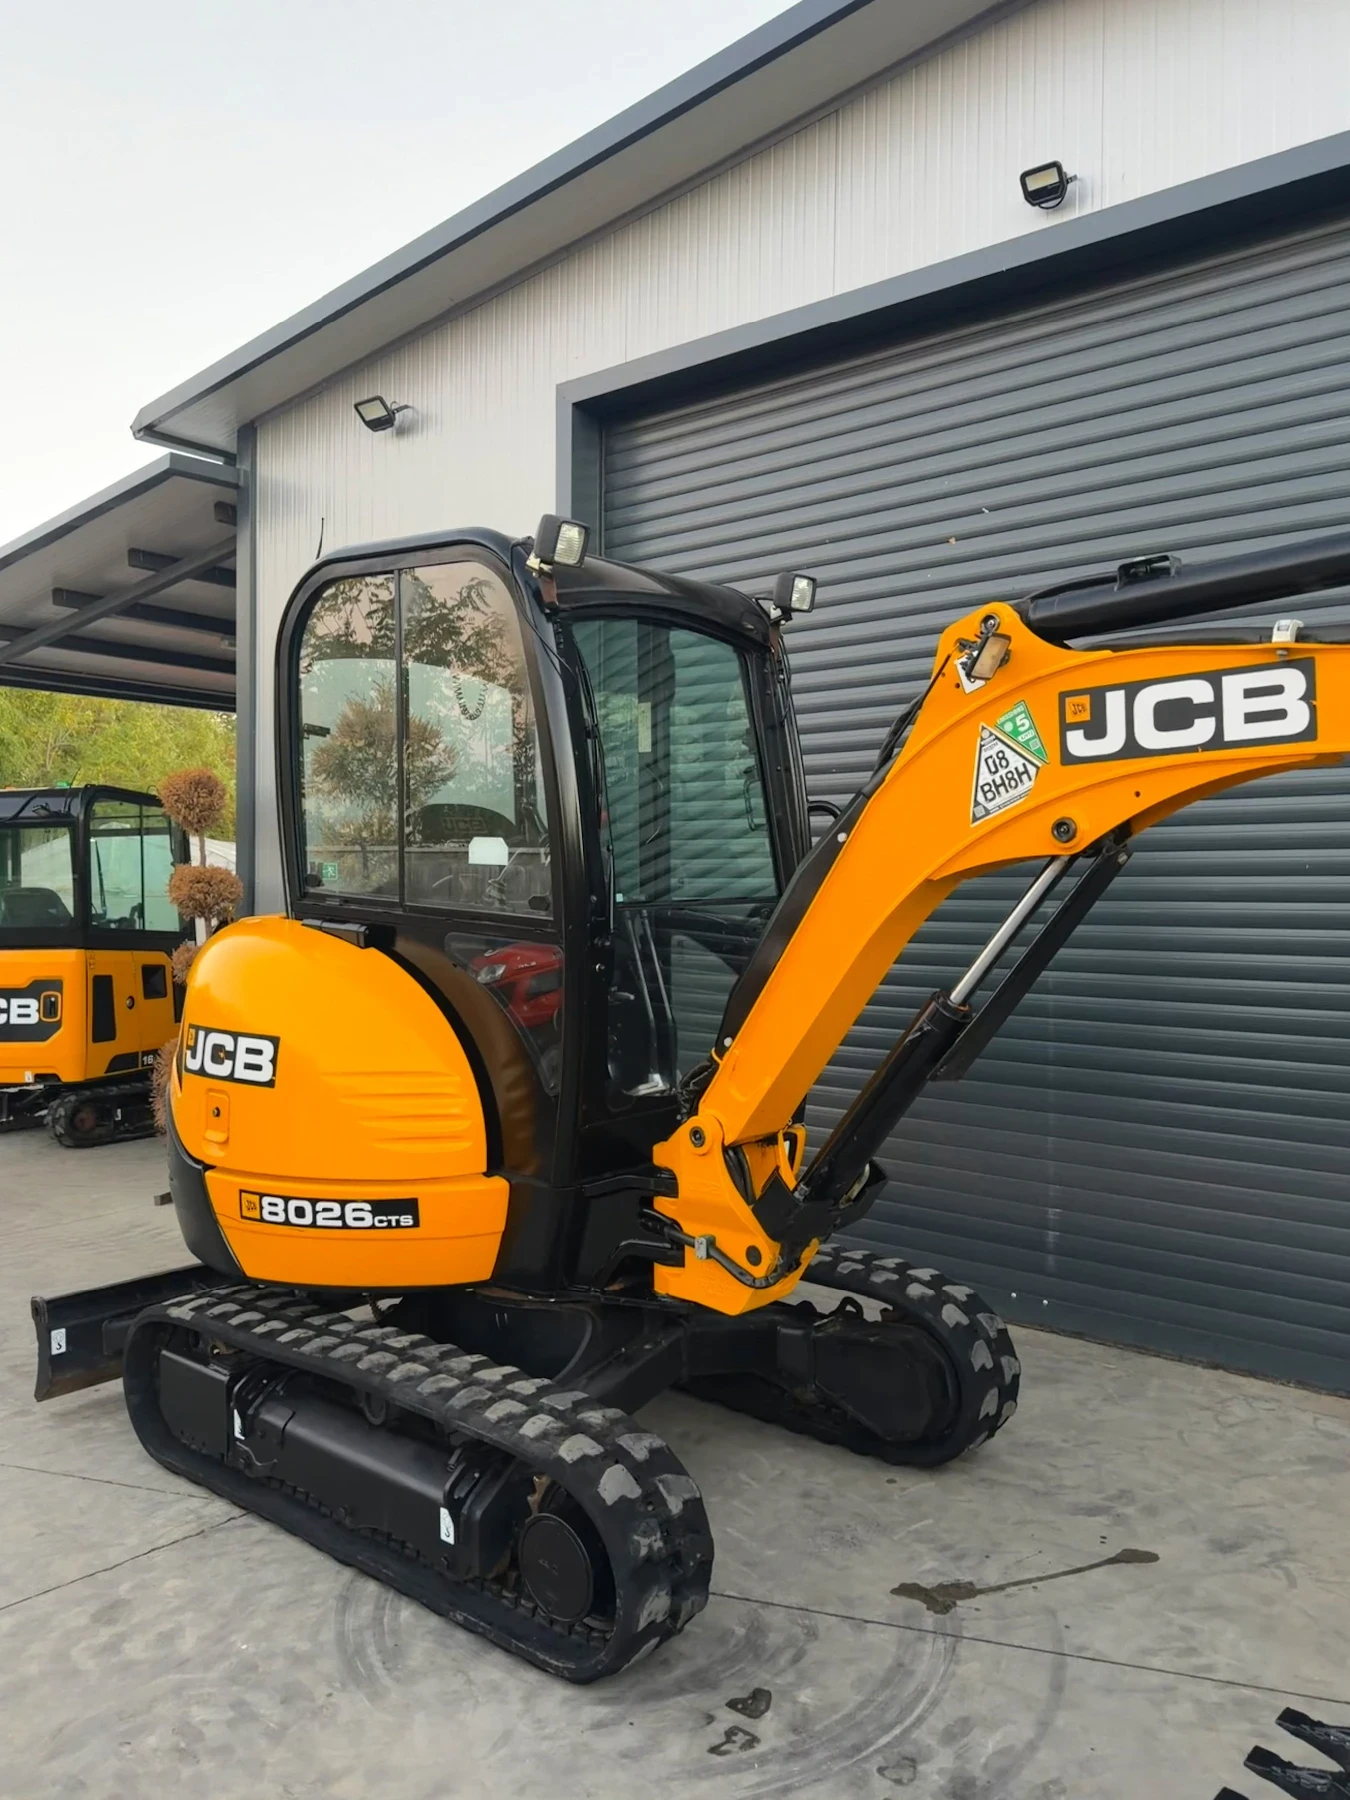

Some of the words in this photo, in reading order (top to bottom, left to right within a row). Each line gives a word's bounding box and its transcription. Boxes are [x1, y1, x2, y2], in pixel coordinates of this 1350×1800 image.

[1015, 713, 1030, 732] 5
[1066, 667, 1310, 757] JCB
[980, 762, 1032, 803] BH8H
[0, 998, 39, 1024] B
[185, 1030, 274, 1082] JCB
